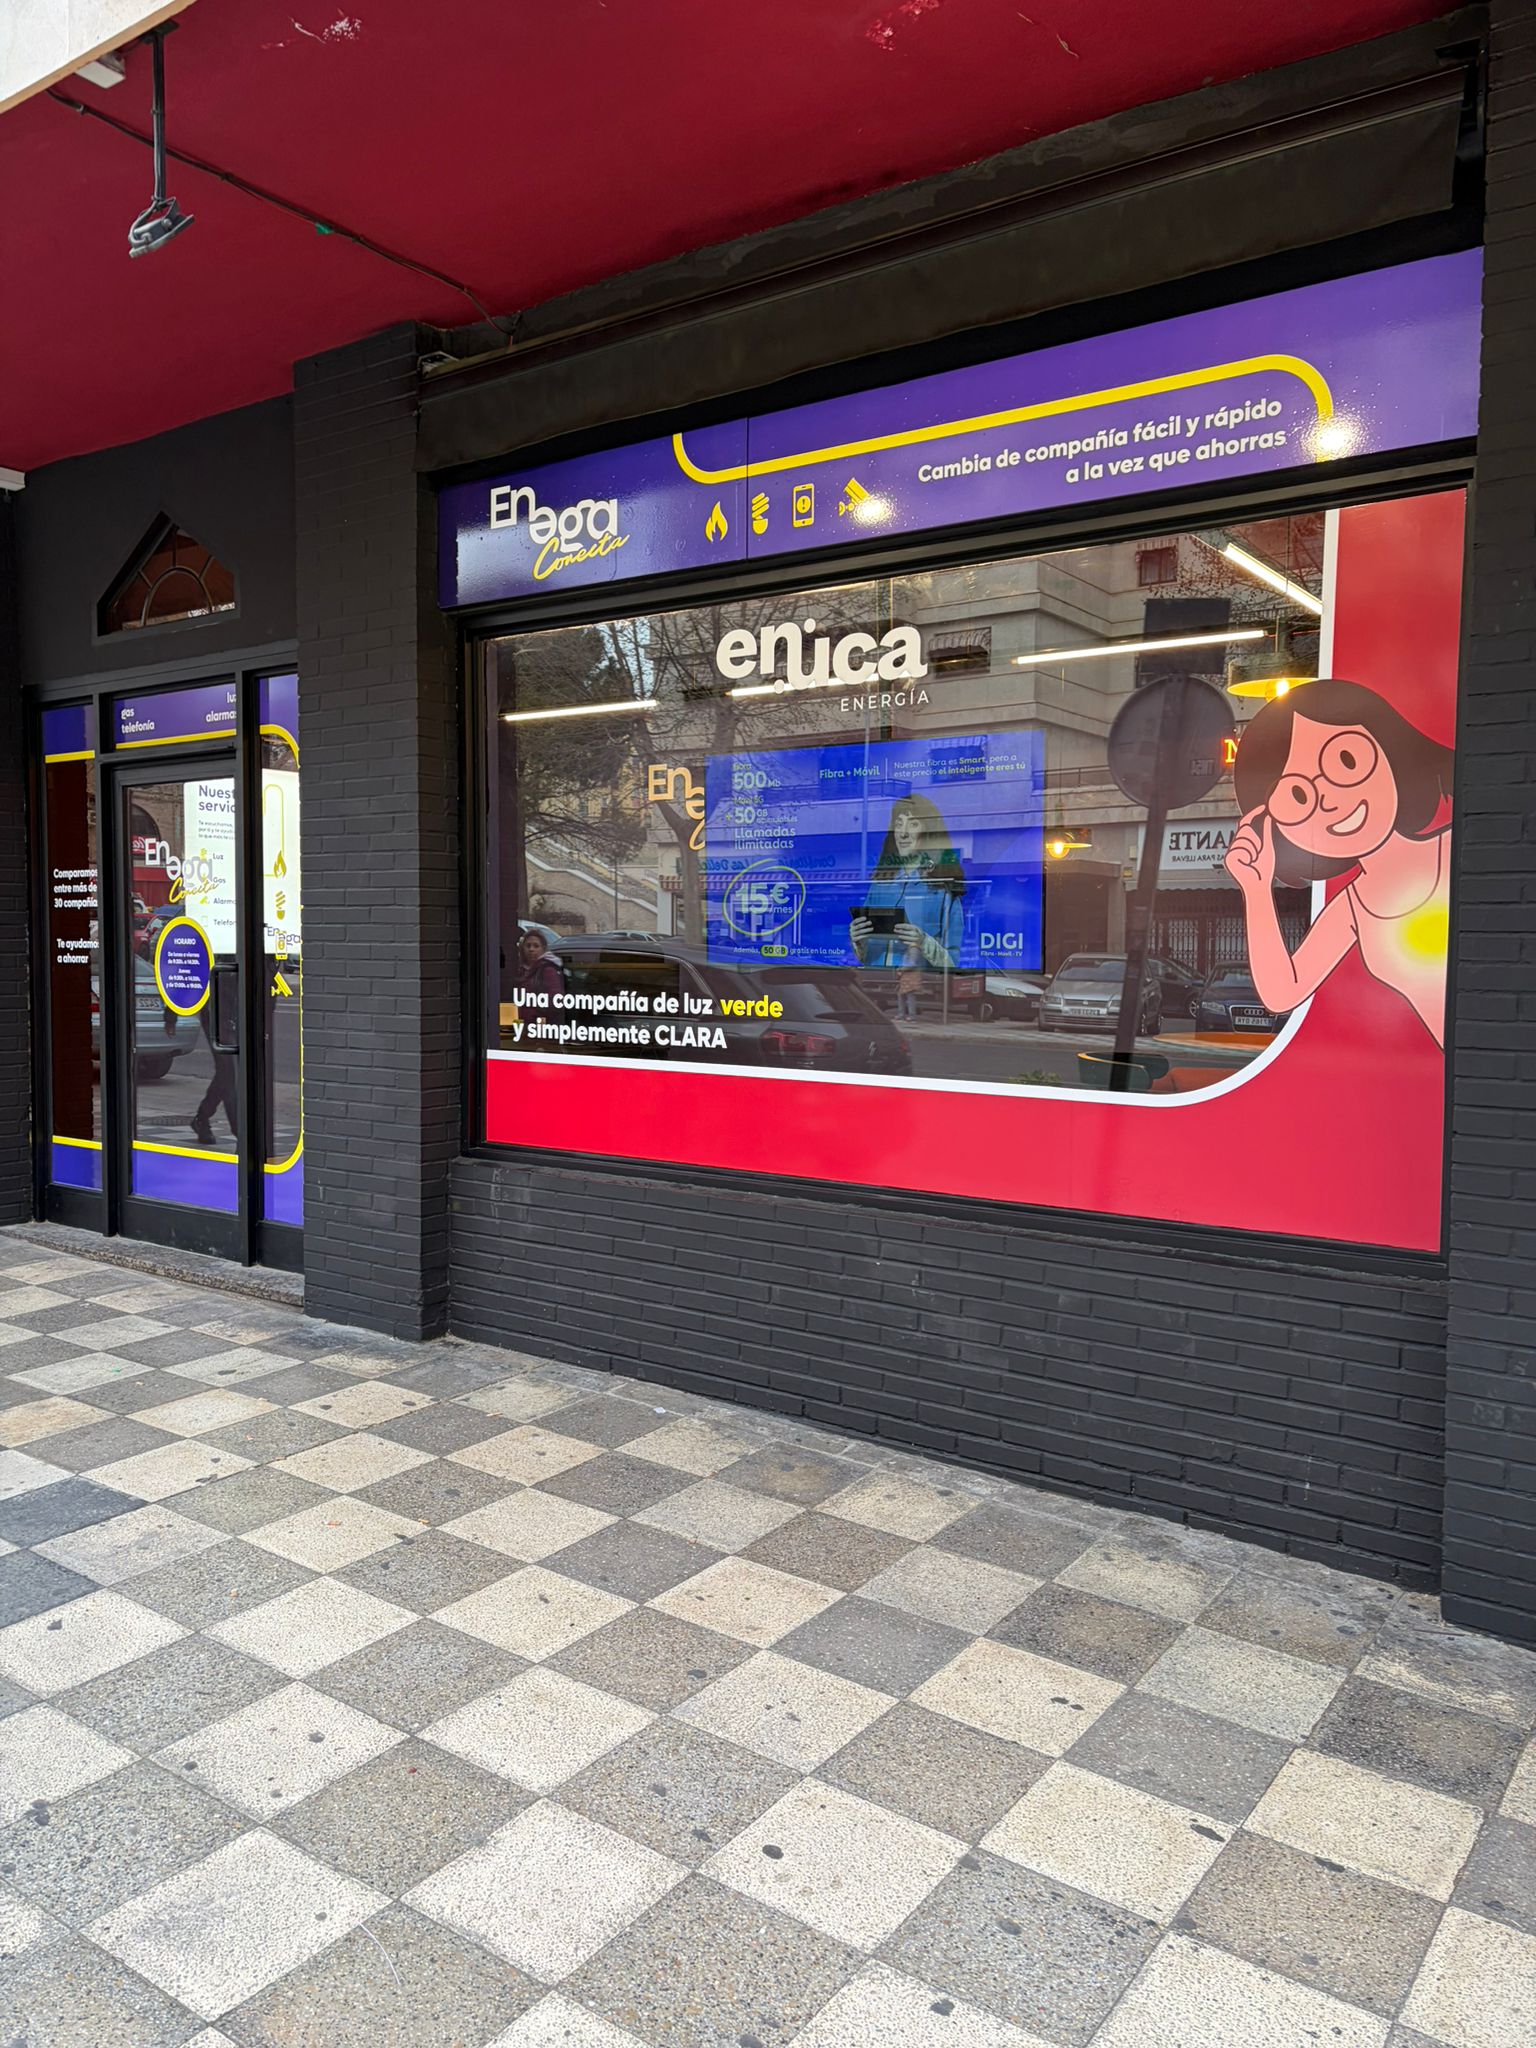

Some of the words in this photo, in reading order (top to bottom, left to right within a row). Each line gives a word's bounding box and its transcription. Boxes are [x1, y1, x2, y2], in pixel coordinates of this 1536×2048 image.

[917, 453, 992, 483] Cambia
[995, 448, 1022, 468] de
[1024, 428, 1129, 464] compañía
[1132, 416, 1182, 443] fácil
[1185, 415, 1200, 437] y
[1204, 398, 1283, 431] rápido
[1065, 467, 1079, 484] a
[1084, 460, 1104, 480] la
[1108, 456, 1145, 477] vez
[1149, 448, 1191, 475] que
[1195, 428, 1288, 461] ahorras
[840, 688, 930, 712] ENERGÍA
[121, 708, 135, 719] gas
[121, 720, 155, 733] telefonía
[894, 760, 925, 770] Nuestra
[927, 758, 946, 767] fibra
[989, 756, 1009, 765] pero
[894, 770, 911, 778] este
[912, 768, 937, 778] precio
[939, 767, 947, 775] el
[948, 764, 995, 775] inteligente
[996, 763, 1015, 772] eres
[1016, 761, 1026, 770] tú
[820, 769, 844, 779] Fibra
[854, 765, 880, 777] Móvil
[734, 771, 767, 789] 500
[199, 784, 236, 799] Nues
[735, 807, 756, 824] 50
[734, 826, 796, 838] Llamadas
[734, 839, 795, 850] ilimitadas
[212, 852, 224, 860] Luz
[54, 884, 72, 893] entre
[72, 882, 87, 893] más
[88, 882, 97, 892] de
[54, 898, 63, 908] 30
[56, 938, 65, 948] Te
[981, 932, 1023, 950] DIGI
[57, 955, 63, 963] a
[63, 953, 89, 963] ahorrar
[513, 987, 550, 1008] Una
[553, 990, 649, 1015] compañía
[653, 991, 680, 1014] de
[684, 992, 713, 1015] luz
[720, 995, 783, 1018] verde
[513, 1021, 524, 1041] y
[527, 1017, 651, 1045] simplemente
[655, 1024, 728, 1048] CLARA
